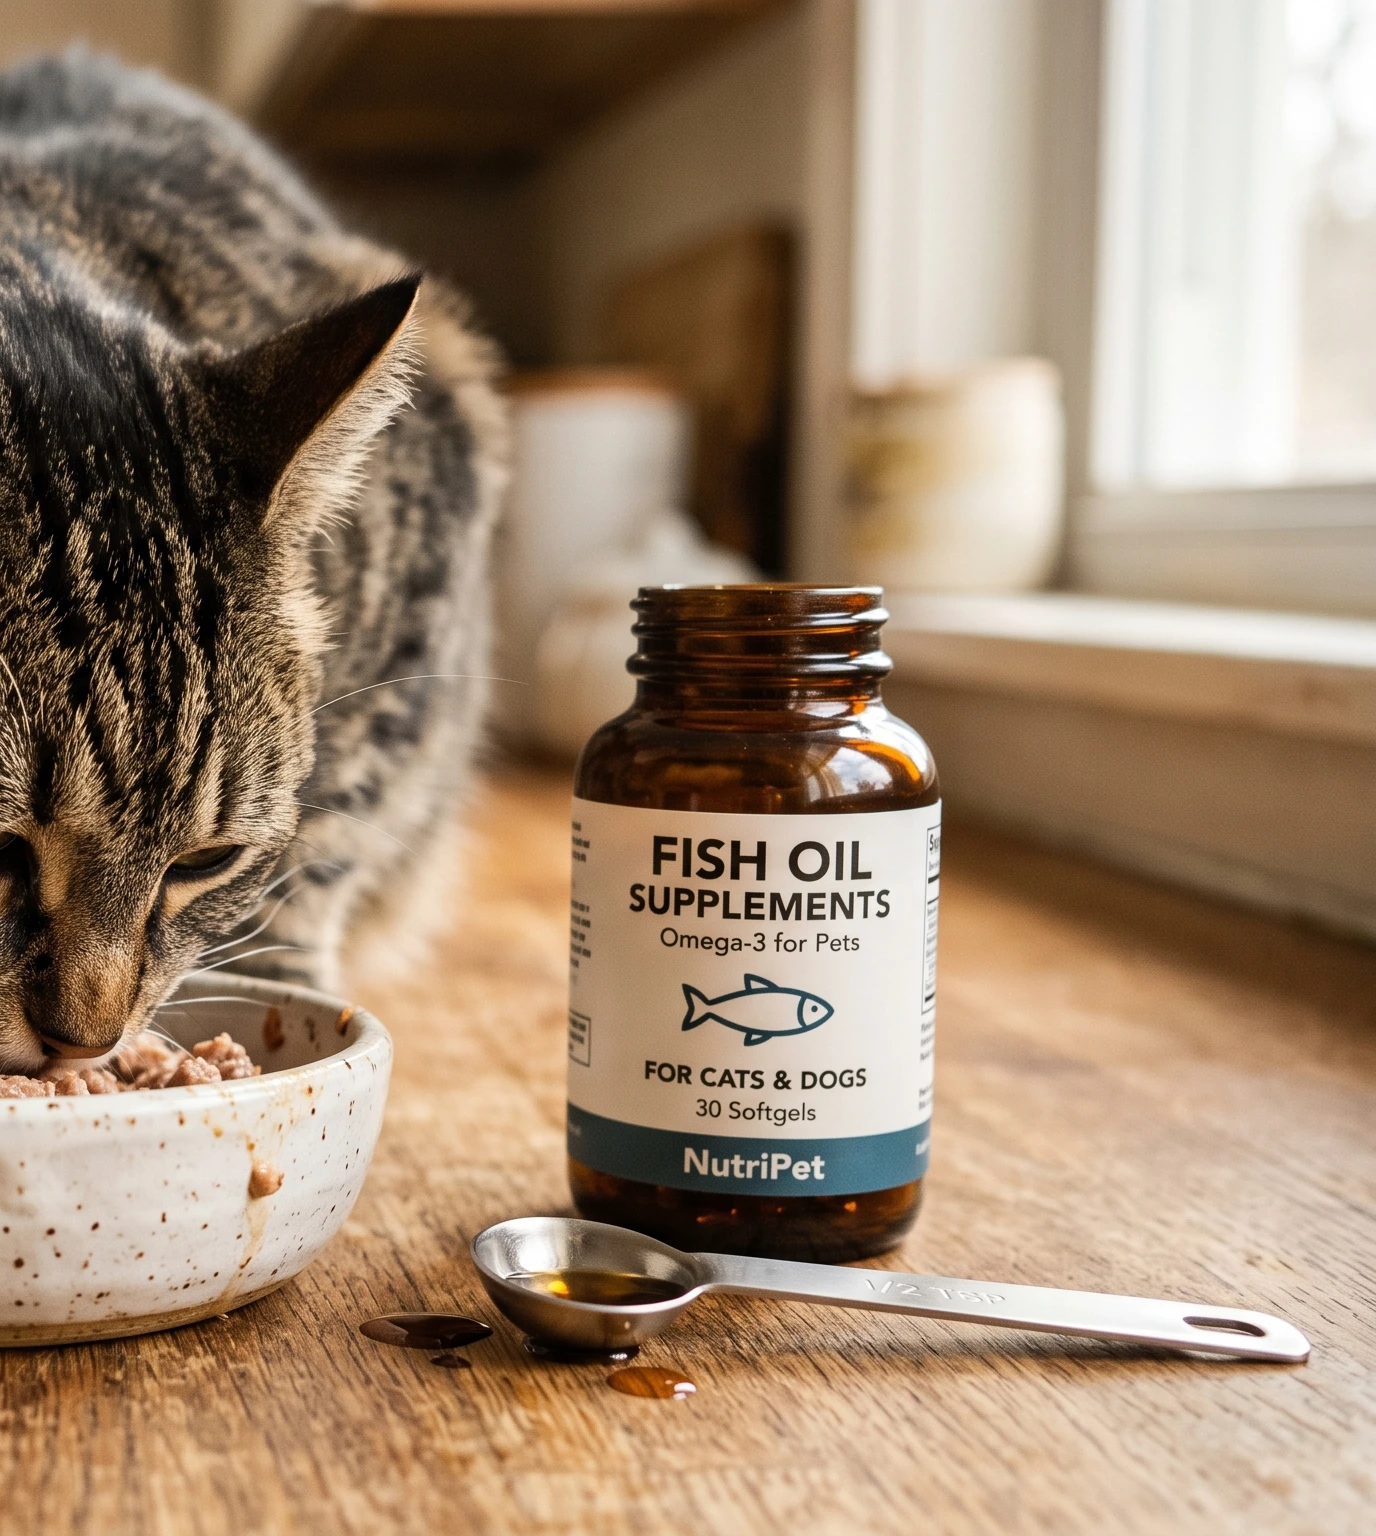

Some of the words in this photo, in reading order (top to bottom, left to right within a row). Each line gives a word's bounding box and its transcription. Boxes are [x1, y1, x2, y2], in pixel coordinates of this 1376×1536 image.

[652, 835, 767, 881] FISH
[788, 840, 872, 883] OIL
[628, 883, 890, 921] SUPPLEMENTS
[659, 926, 766, 957] Omega-3
[773, 931, 808, 953] for
[816, 933, 860, 953] Pets
[644, 1060, 692, 1085] FOR
[699, 1066, 765, 1090] CATS
[772, 1069, 792, 1091] &
[800, 1067, 867, 1090] DOGS
[695, 1098, 722, 1118] 30
[728, 1100, 816, 1127] Softgels
[684, 1148, 826, 1181] NutriPet
